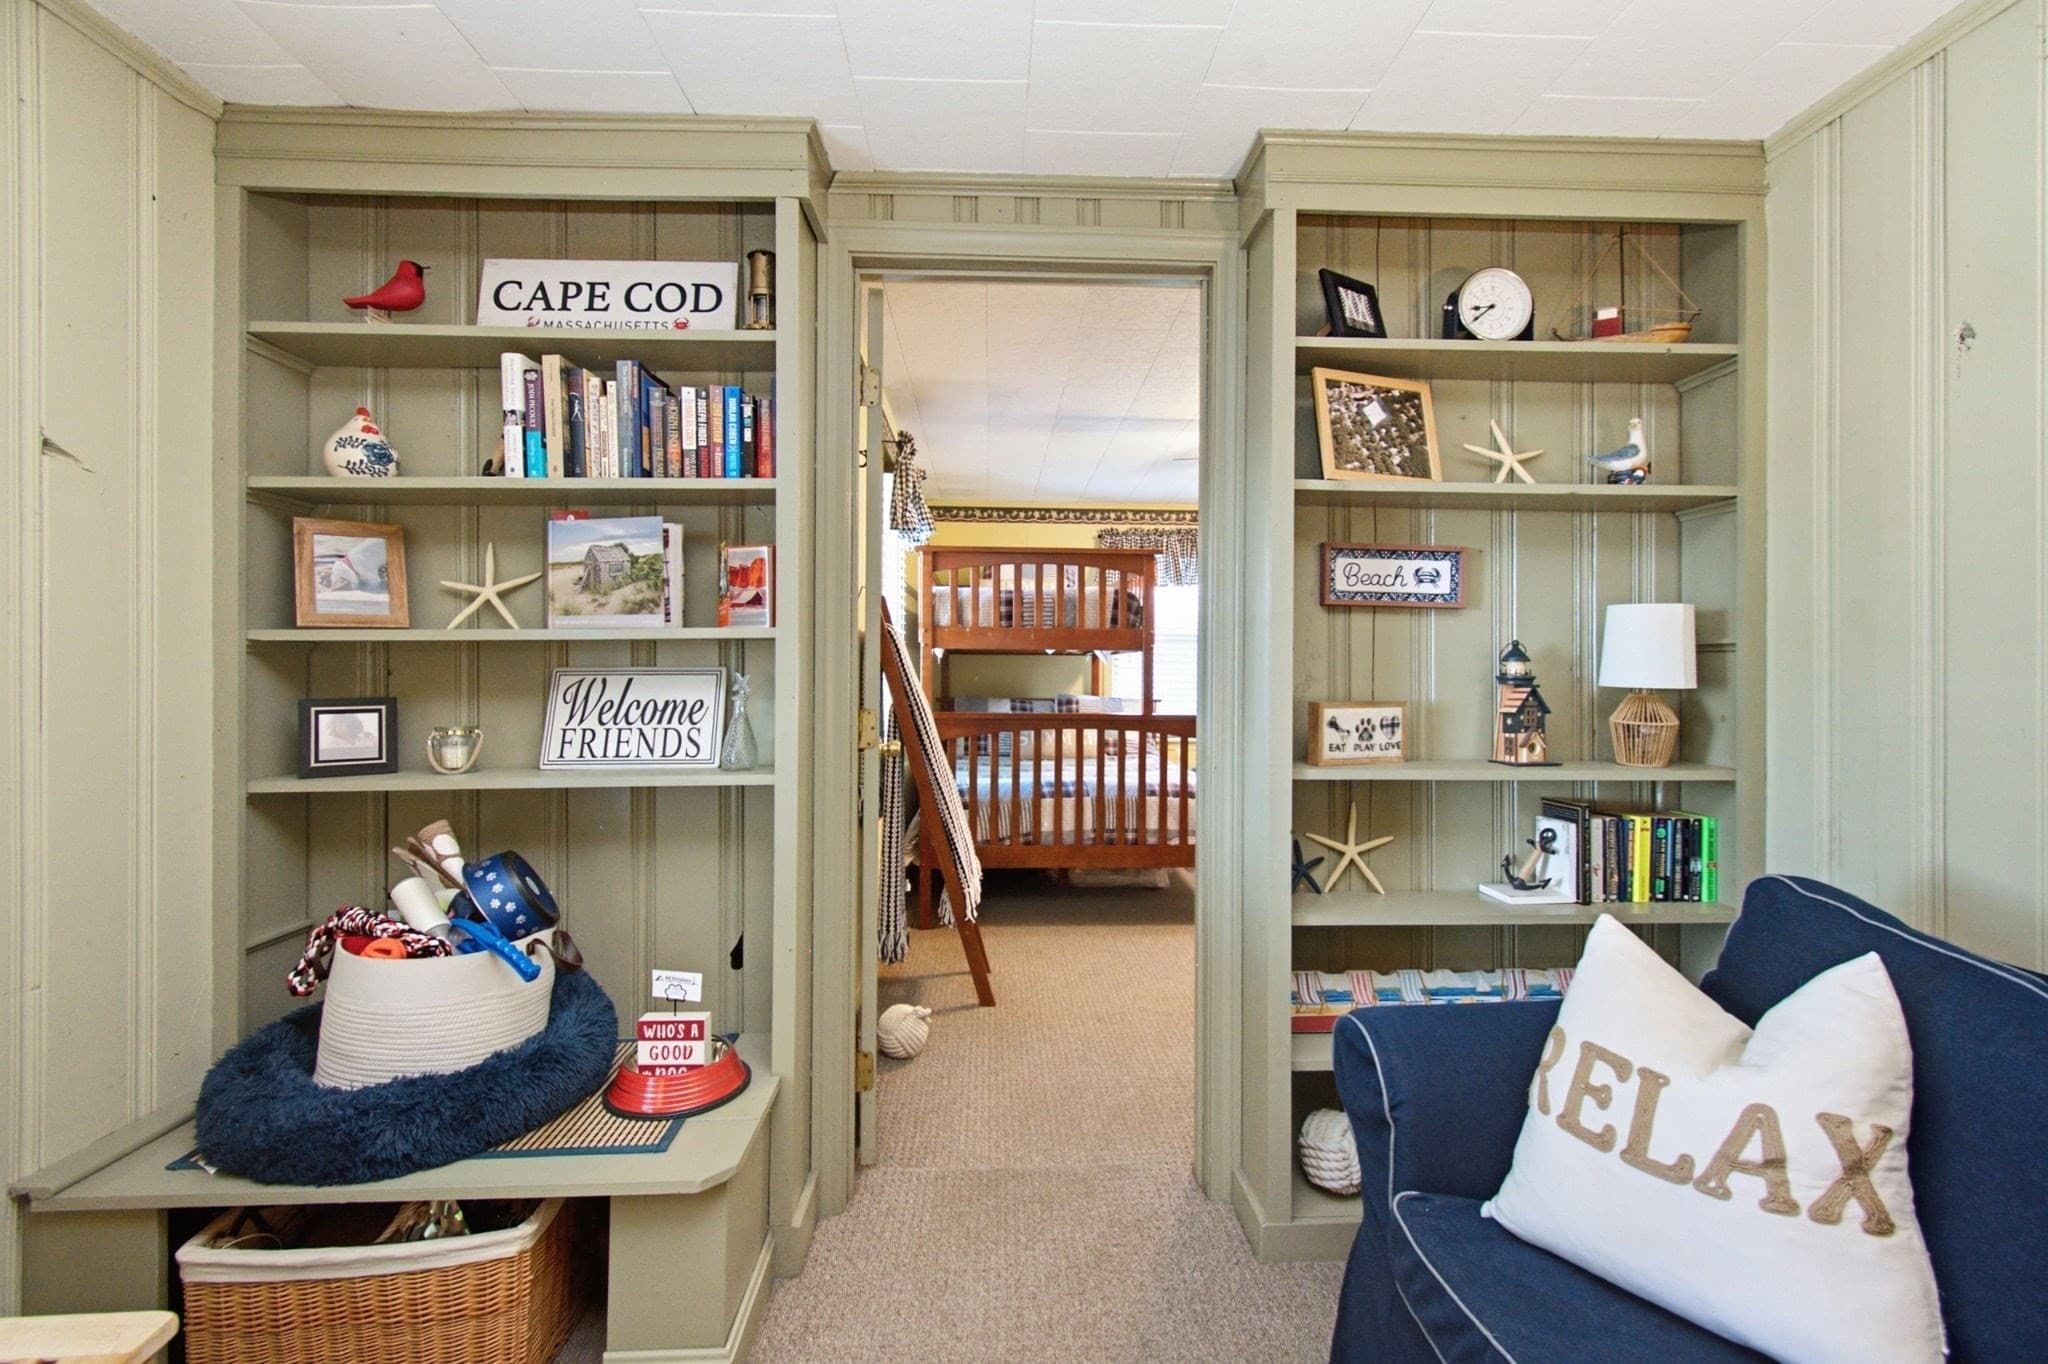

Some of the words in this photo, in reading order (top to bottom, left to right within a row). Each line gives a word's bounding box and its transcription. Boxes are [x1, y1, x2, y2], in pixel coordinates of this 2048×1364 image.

[493, 280, 610, 312] CAPE
[624, 282, 723, 313] COD
[1343, 562, 1408, 587] Beach
[563, 677, 709, 726] Welcome
[556, 727, 702, 758] FRIENDS
[1328, 743, 1346, 752] EAT
[1353, 743, 1375, 752] PLAY
[1379, 741, 1401, 751] LOVE
[643, 1023, 685, 1039] WHO'S
[690, 1023, 699, 1037] A
[649, 1045, 693, 1060] GOOD
[1536, 1024, 1896, 1237] RELAX
